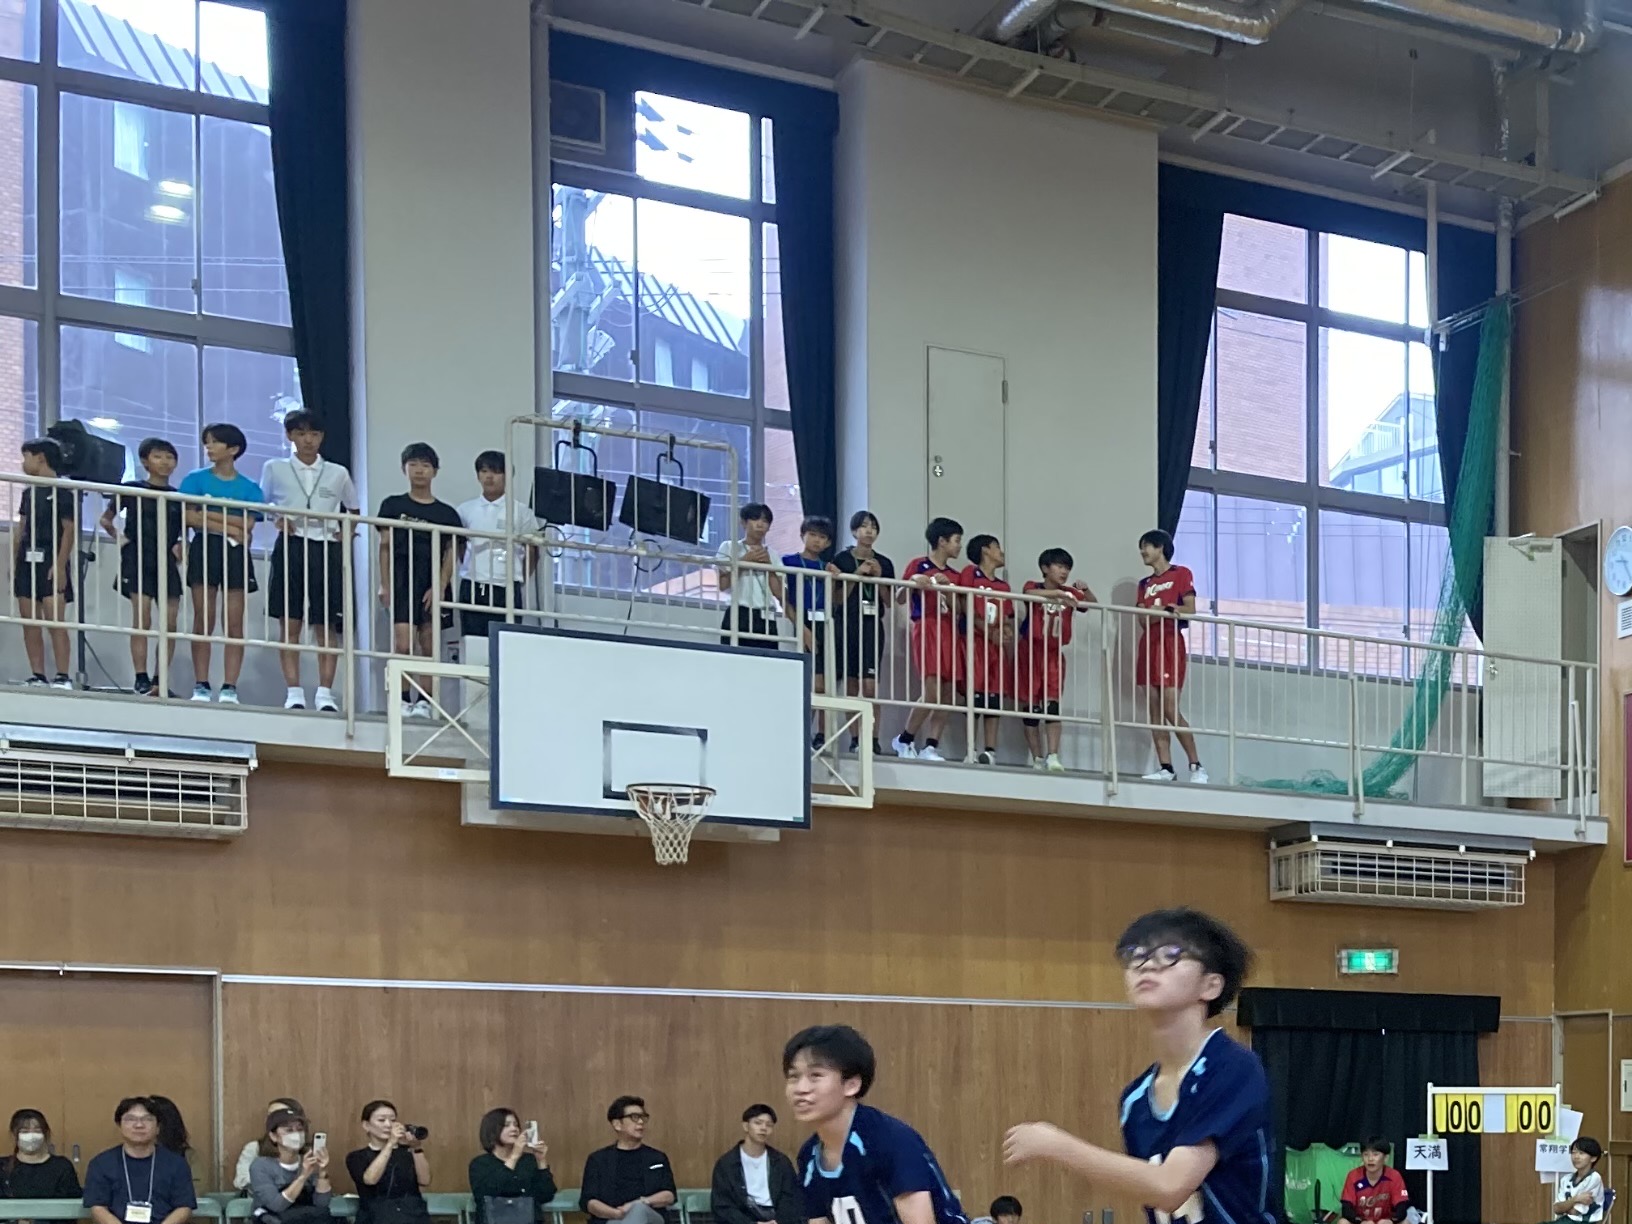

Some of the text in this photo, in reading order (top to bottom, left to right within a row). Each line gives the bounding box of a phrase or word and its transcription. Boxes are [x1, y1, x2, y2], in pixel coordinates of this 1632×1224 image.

[1449, 1100, 1481, 1130] 00
[1519, 1100, 1551, 1130] 00
[1413, 1144, 1442, 1160] 天満
[1539, 1143, 1572, 1155] 常翔学
